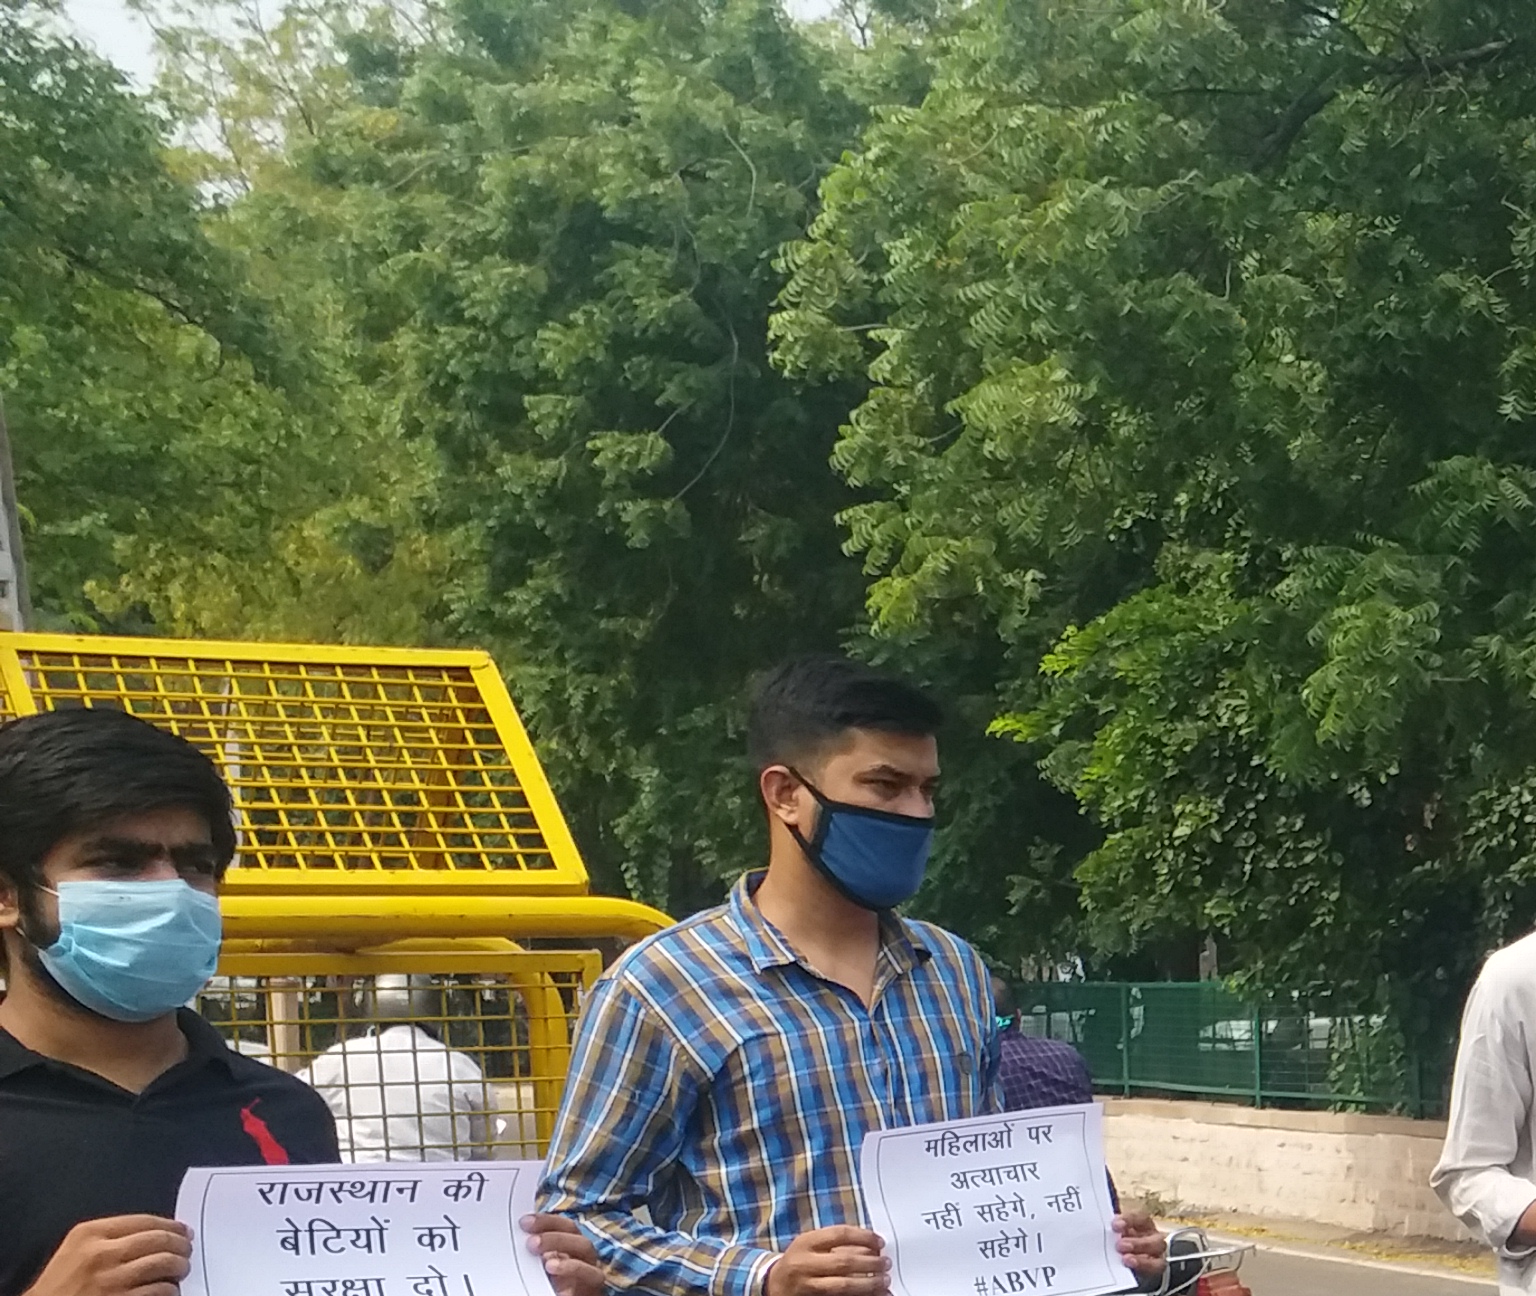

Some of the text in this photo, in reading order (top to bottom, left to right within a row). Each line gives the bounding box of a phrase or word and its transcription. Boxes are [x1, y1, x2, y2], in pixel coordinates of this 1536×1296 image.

[924, 1123, 1053, 1157] महिलाओं पर
[256, 1172, 489, 1205] राजस्थान की
[950, 1162, 1040, 1190] अत्याचार
[921, 1202, 963, 1231] नहीं
[1044, 1186, 1082, 1214] नहीं
[276, 1216, 460, 1255] बेटियों को
[974, 1266, 1056, 1296] #ABVP
